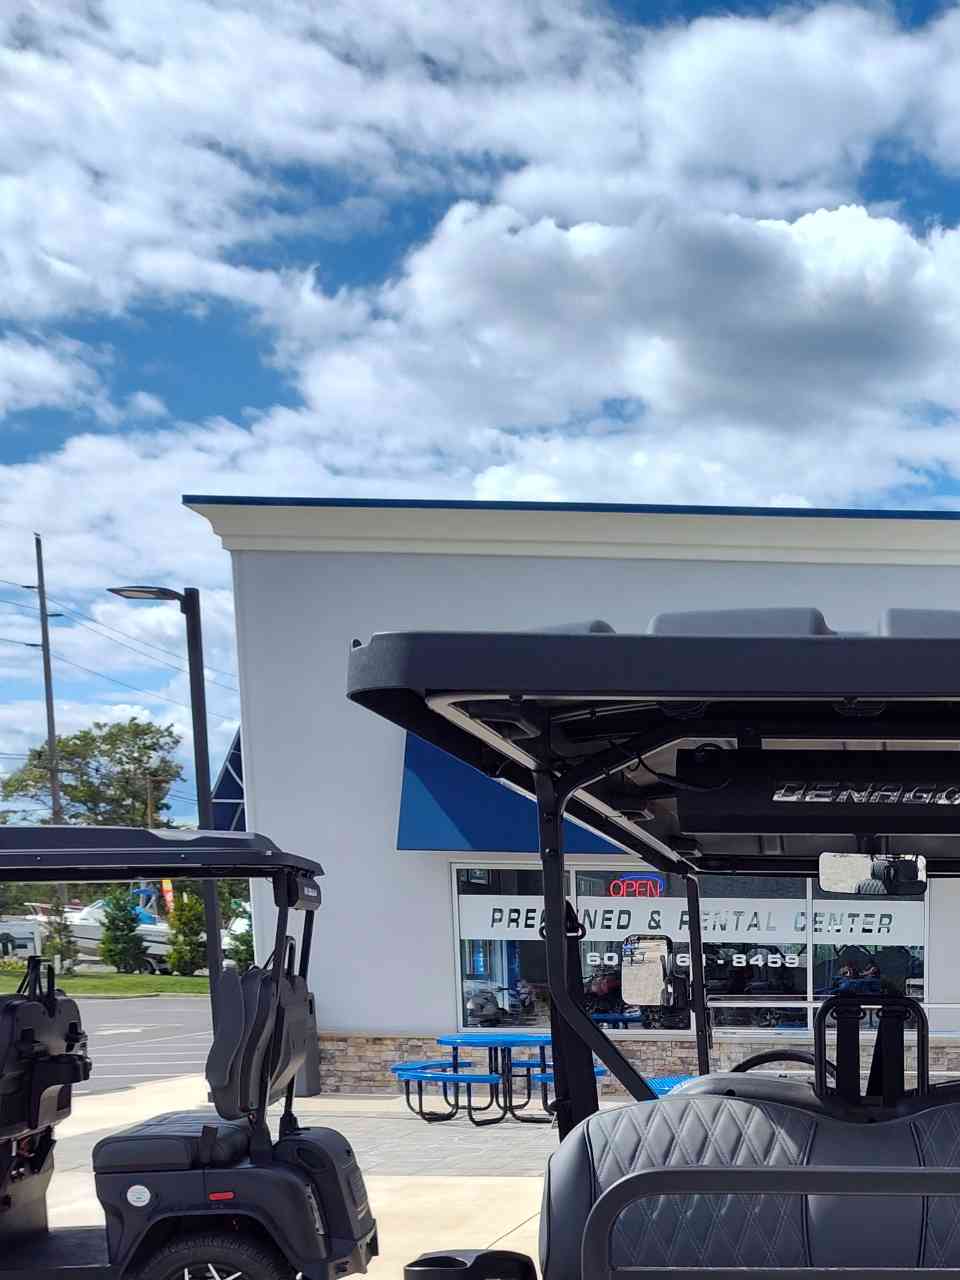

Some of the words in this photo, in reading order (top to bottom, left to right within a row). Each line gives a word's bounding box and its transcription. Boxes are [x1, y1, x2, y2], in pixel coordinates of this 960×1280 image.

[608, 879, 660, 897] OPEN
[490, 907, 632, 930] PRENED
[647, 910, 662, 930] &
[793, 911, 894, 934] CENTER
[732, 953, 800, 967] 8459
